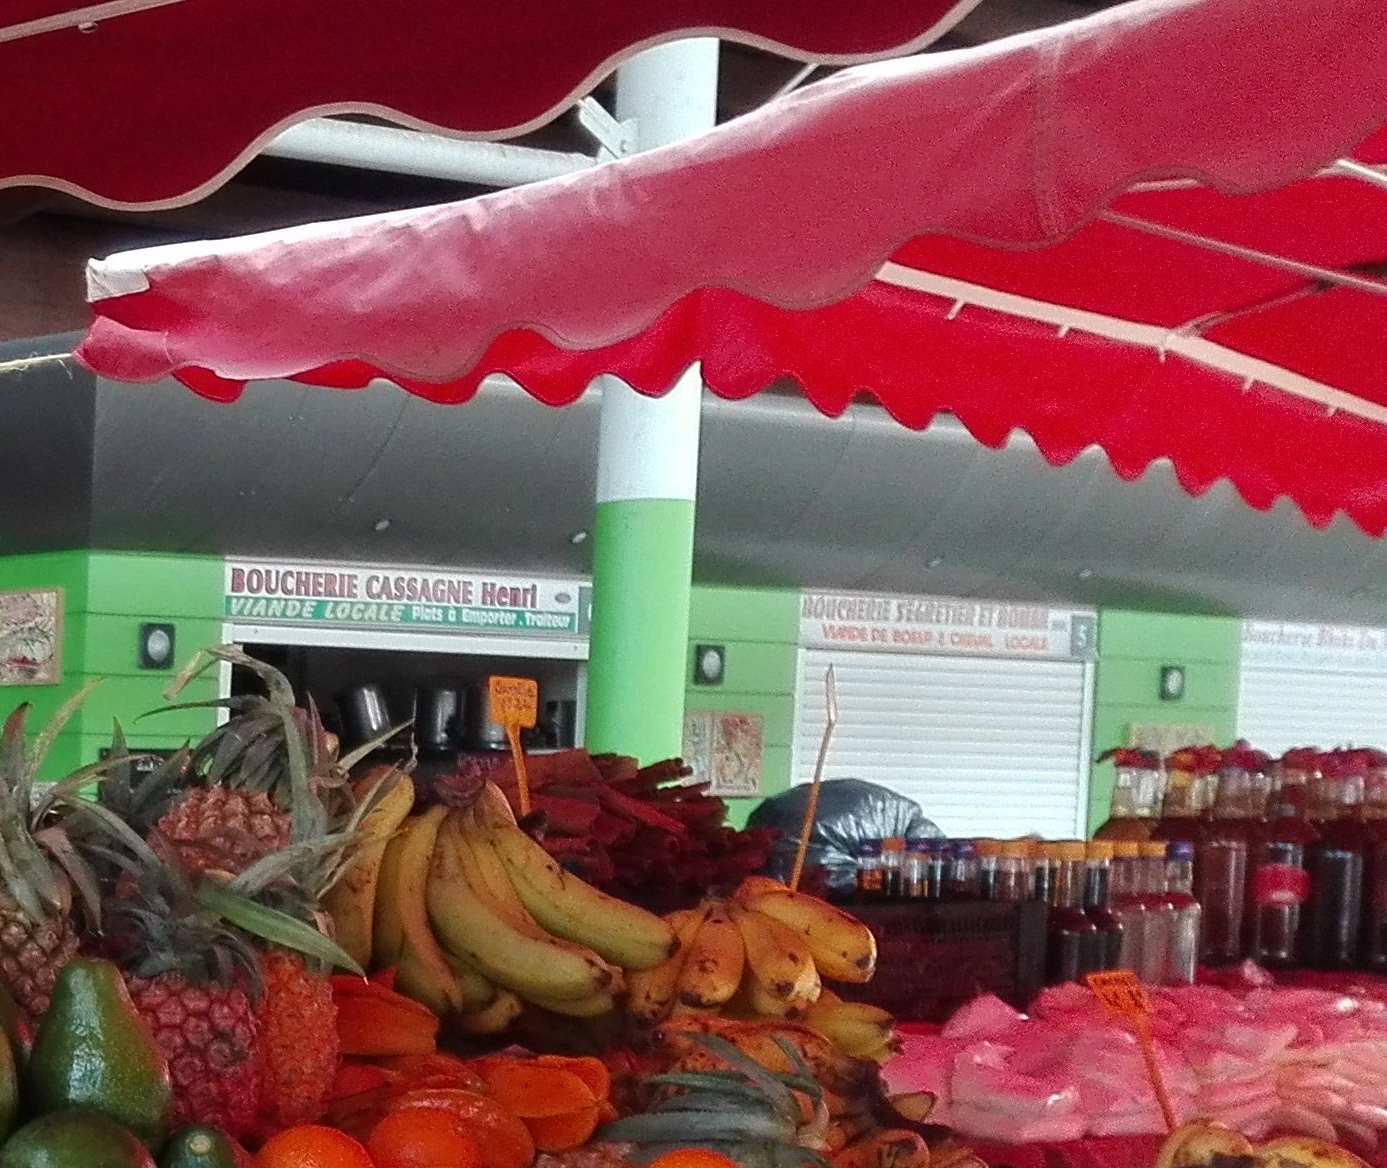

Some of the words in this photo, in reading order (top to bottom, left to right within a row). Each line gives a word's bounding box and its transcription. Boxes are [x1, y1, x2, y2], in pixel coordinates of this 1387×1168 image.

[230, 567, 358, 598] BOUCHERIE
[365, 575, 474, 605] CASSAGNE
[481, 582, 538, 609] Henri
[230, 597, 318, 619] VIANDE
[324, 600, 404, 622] LOCALE
[412, 604, 444, 622] Plats
[448, 605, 457, 622] à
[462, 607, 517, 626] Emporter
[525, 611, 571, 629] Traiteur
[822, 624, 869, 643] VIANDE
[871, 627, 888, 645] DE
